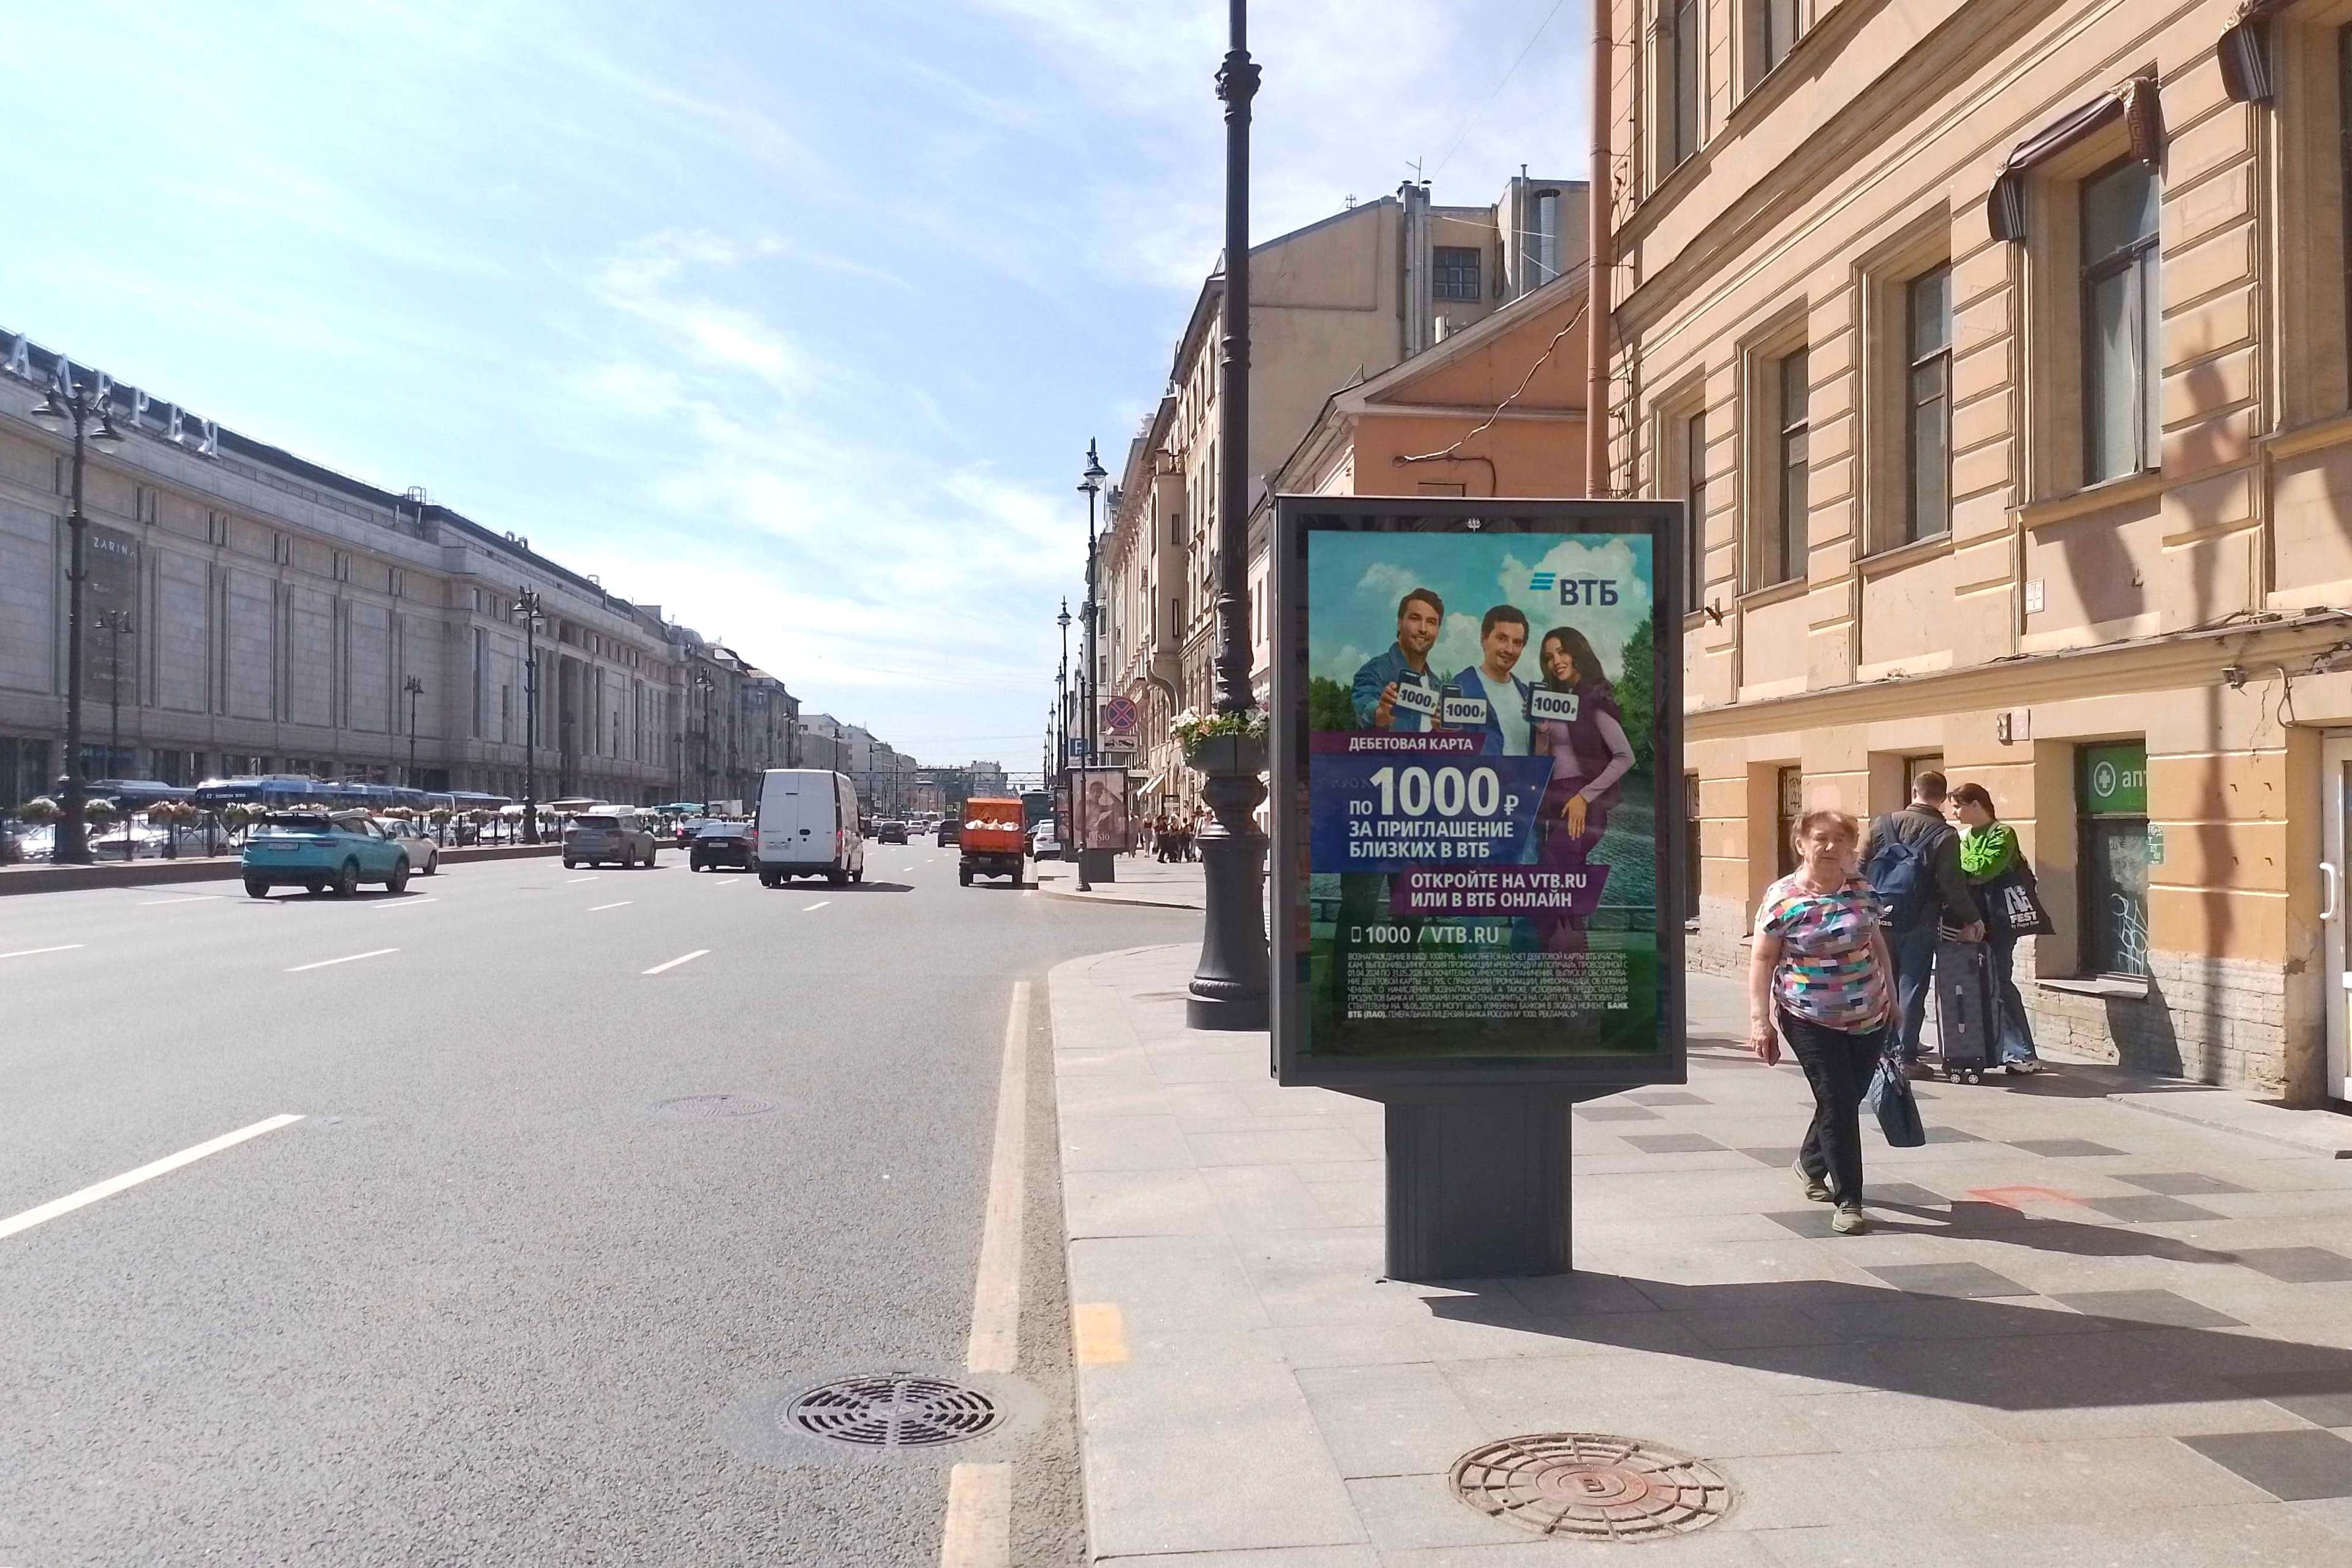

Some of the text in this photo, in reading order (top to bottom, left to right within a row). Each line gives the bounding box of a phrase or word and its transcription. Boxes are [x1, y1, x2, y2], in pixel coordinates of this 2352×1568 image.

[1560, 579, 1618, 606] ВТБ
[1349, 737, 1473, 752] ДЕБЕТОВАЯ КАРТА
[1349, 800, 1373, 815] ПО
[1349, 821, 1513, 837] ЗА ПРИГЛАШЕНИЕ
[1350, 842, 1490, 858] БЛИЗКИХ В ВТБ
[1411, 870, 1587, 888] ОТКРОЙТЕ НА VTB.RU
[1411, 890, 1572, 908] ИЛИ В ВТБ ОНЛАЙН
[2010, 911, 2037, 924] FEST
[1365, 926, 1411, 943] 1000
[1430, 926, 1499, 944] VTB.RU
